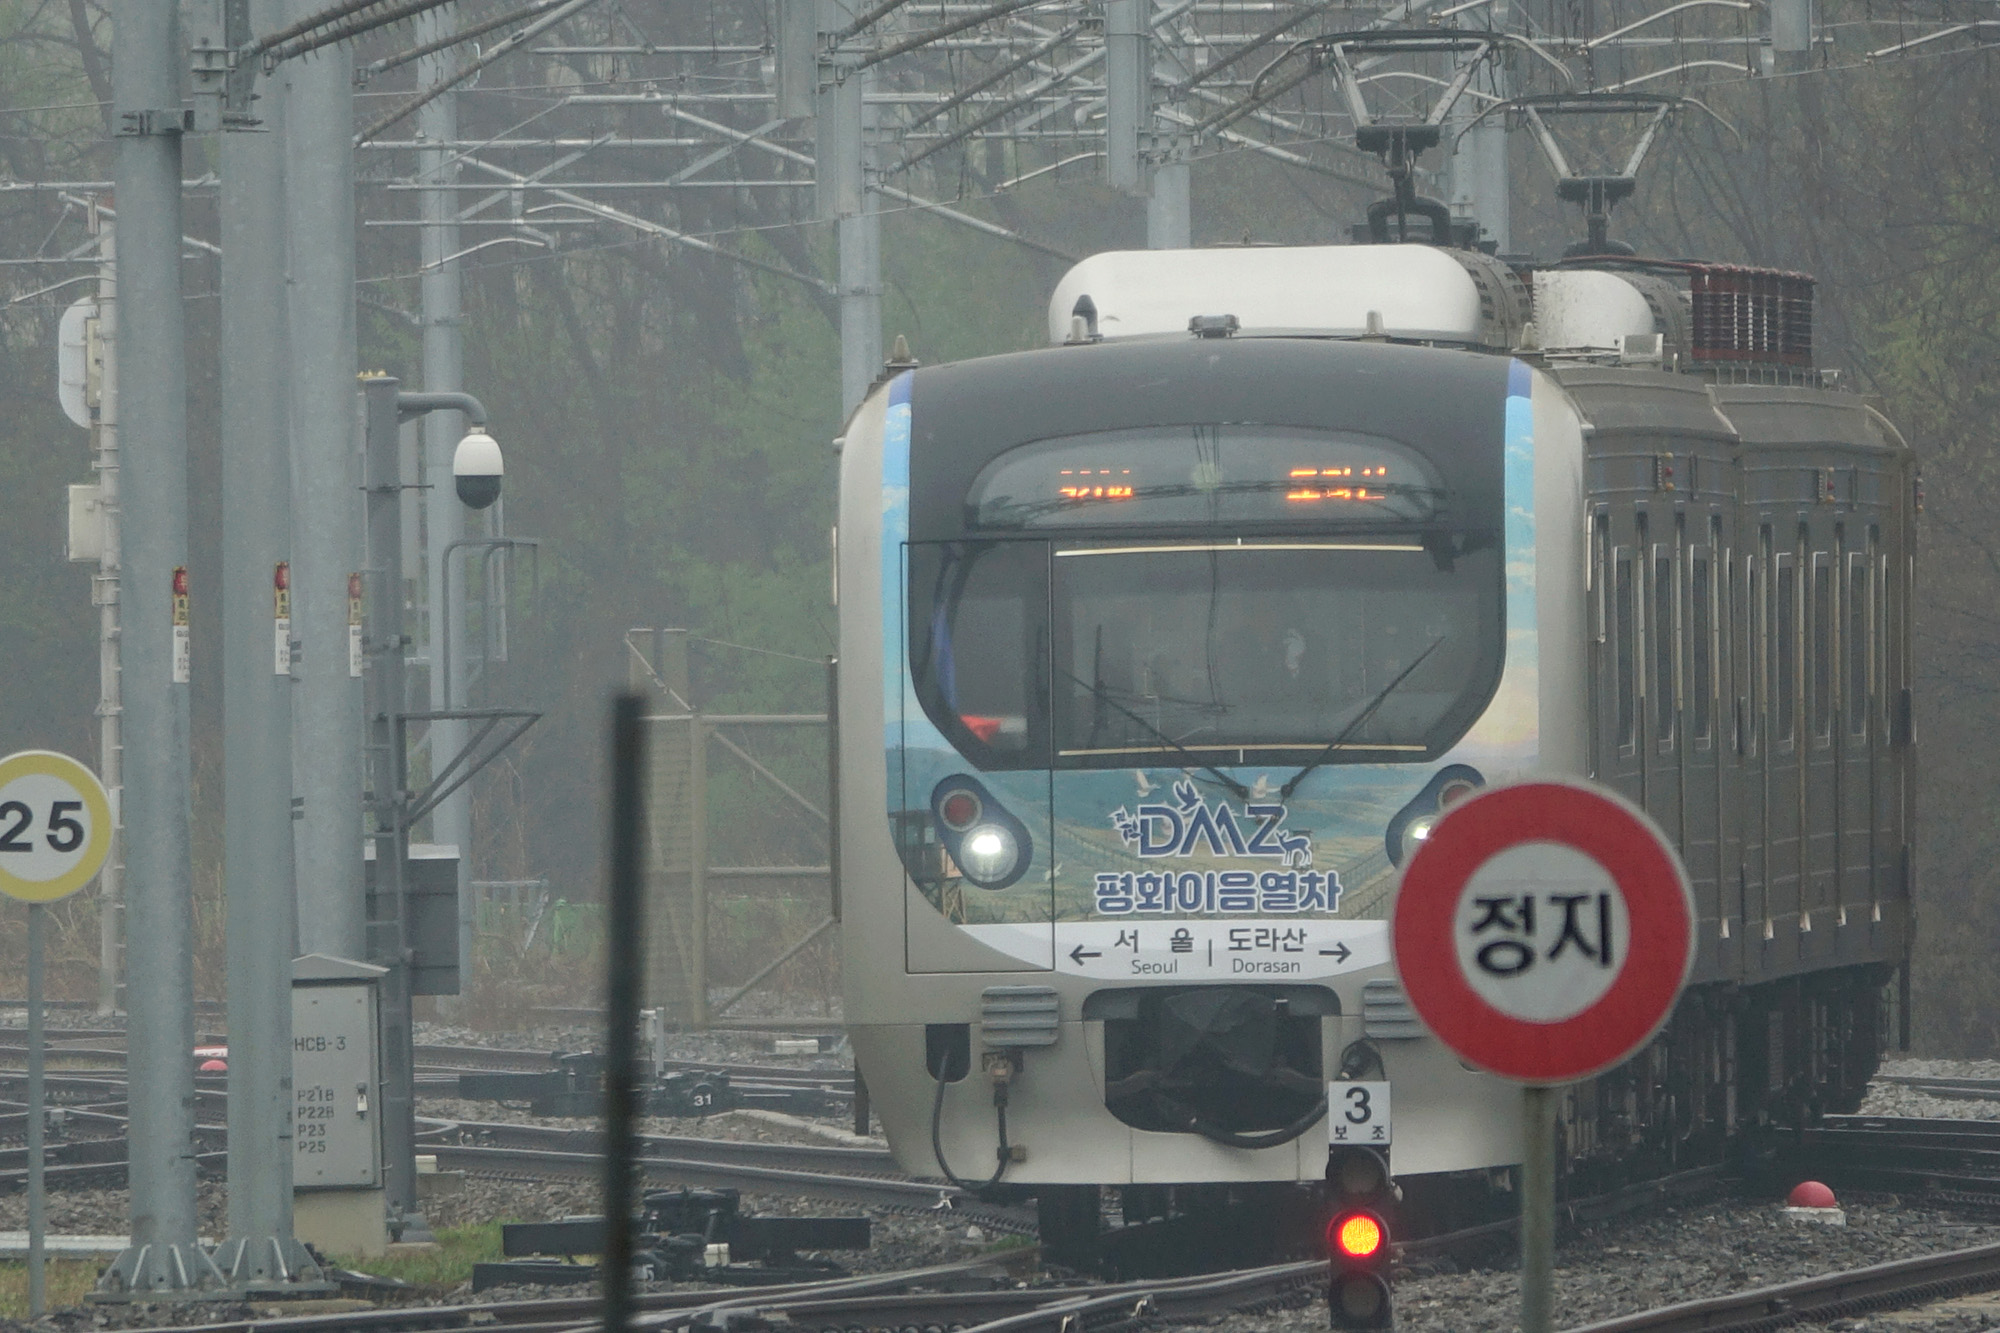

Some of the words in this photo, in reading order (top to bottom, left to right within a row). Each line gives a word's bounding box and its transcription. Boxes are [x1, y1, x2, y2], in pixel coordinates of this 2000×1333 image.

[0, 801, 84, 852] 25
[1137, 803, 1288, 858] DMZ
[1095, 870, 1342, 915] 평화이음열차
[1228, 927, 1308, 953] 도라산
[1472, 892, 1615, 978] 정지
[1131, 958, 1178, 975] Seoul
[1232, 957, 1301, 974] Dorasan
[294, 1036, 346, 1051] HCB-3
[693, 1093, 712, 1106] 31
[1345, 1086, 1372, 1124] 3
[298, 1123, 326, 1137] P23
[298, 1140, 326, 1153] P25
